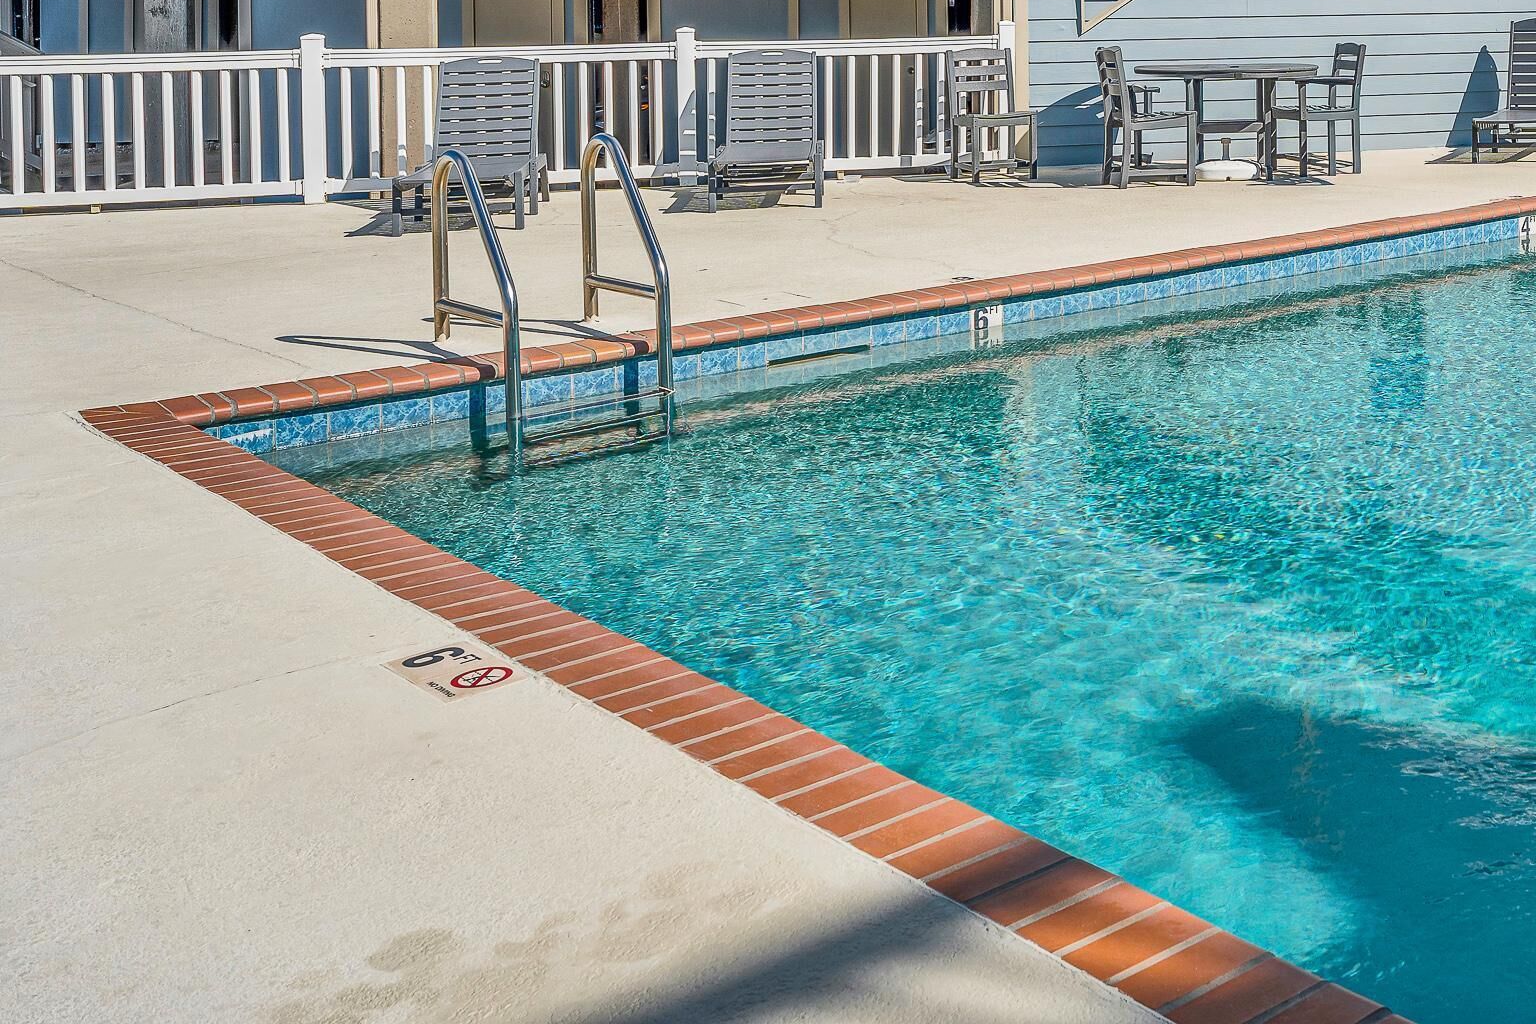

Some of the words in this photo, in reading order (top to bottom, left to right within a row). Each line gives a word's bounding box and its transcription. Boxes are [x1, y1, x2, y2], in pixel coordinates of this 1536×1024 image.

[1521, 216, 1531, 236] 4
[974, 307, 988, 330] 6
[401, 646, 465, 668] 6
[452, 653, 482, 665] FT
